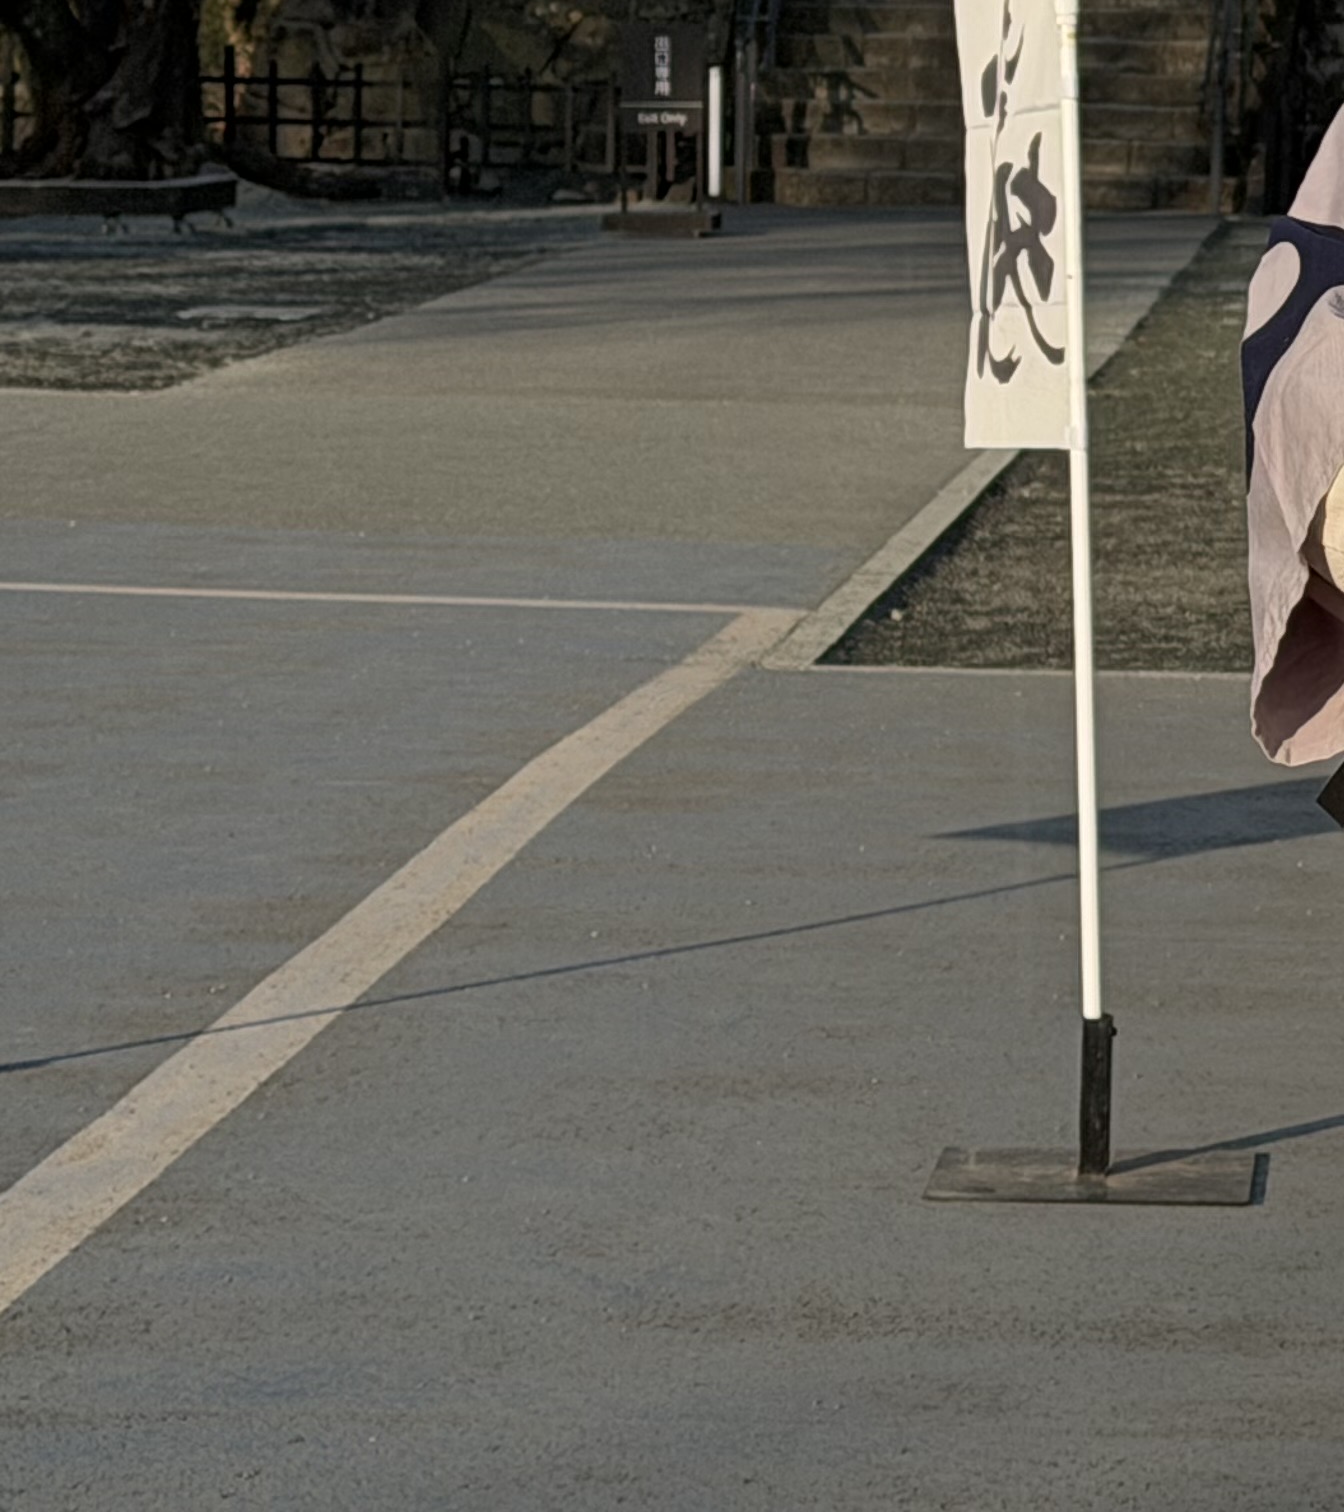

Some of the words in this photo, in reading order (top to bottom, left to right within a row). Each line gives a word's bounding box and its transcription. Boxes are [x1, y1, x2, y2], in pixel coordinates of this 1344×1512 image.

[654, 36, 671, 97] 出口専用
[637, 112, 659, 124] Exit
[660, 112, 687, 126] Only
